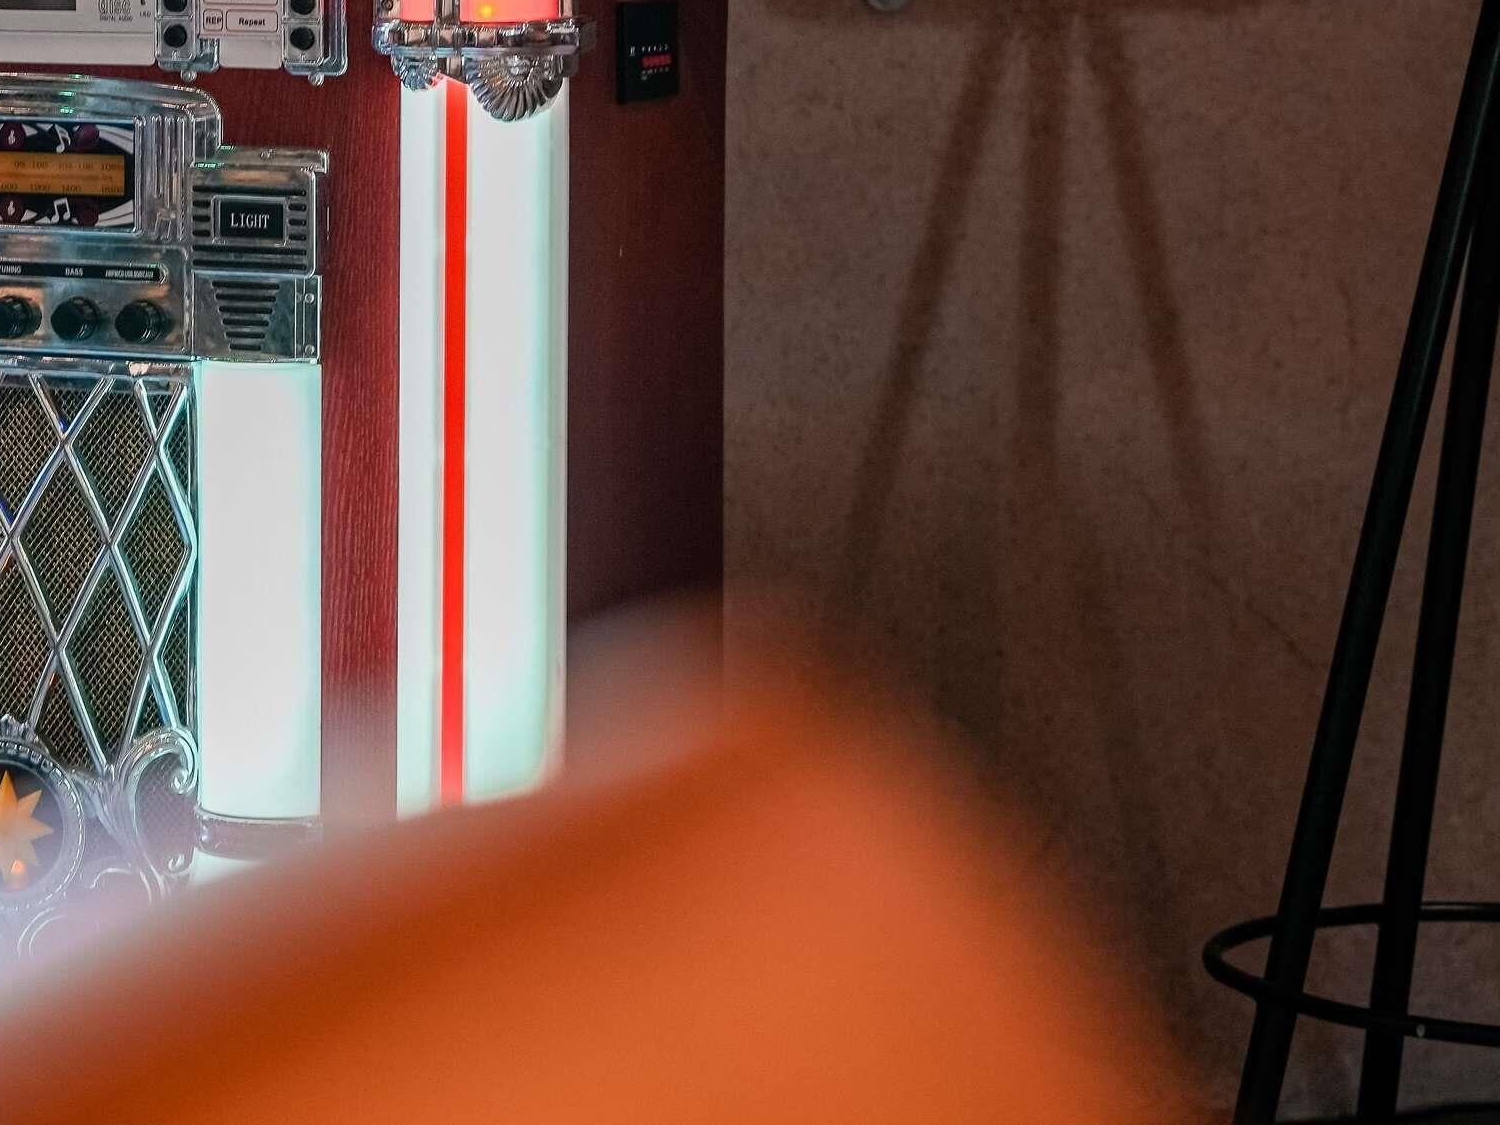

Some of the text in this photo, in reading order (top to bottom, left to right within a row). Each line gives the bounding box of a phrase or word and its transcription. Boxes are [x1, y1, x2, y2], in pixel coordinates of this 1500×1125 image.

[205, 17, 222, 25] REP
[239, 18, 266, 27] Repeat
[231, 213, 270, 230] LIGHT
[65, 266, 84, 276] BASS
